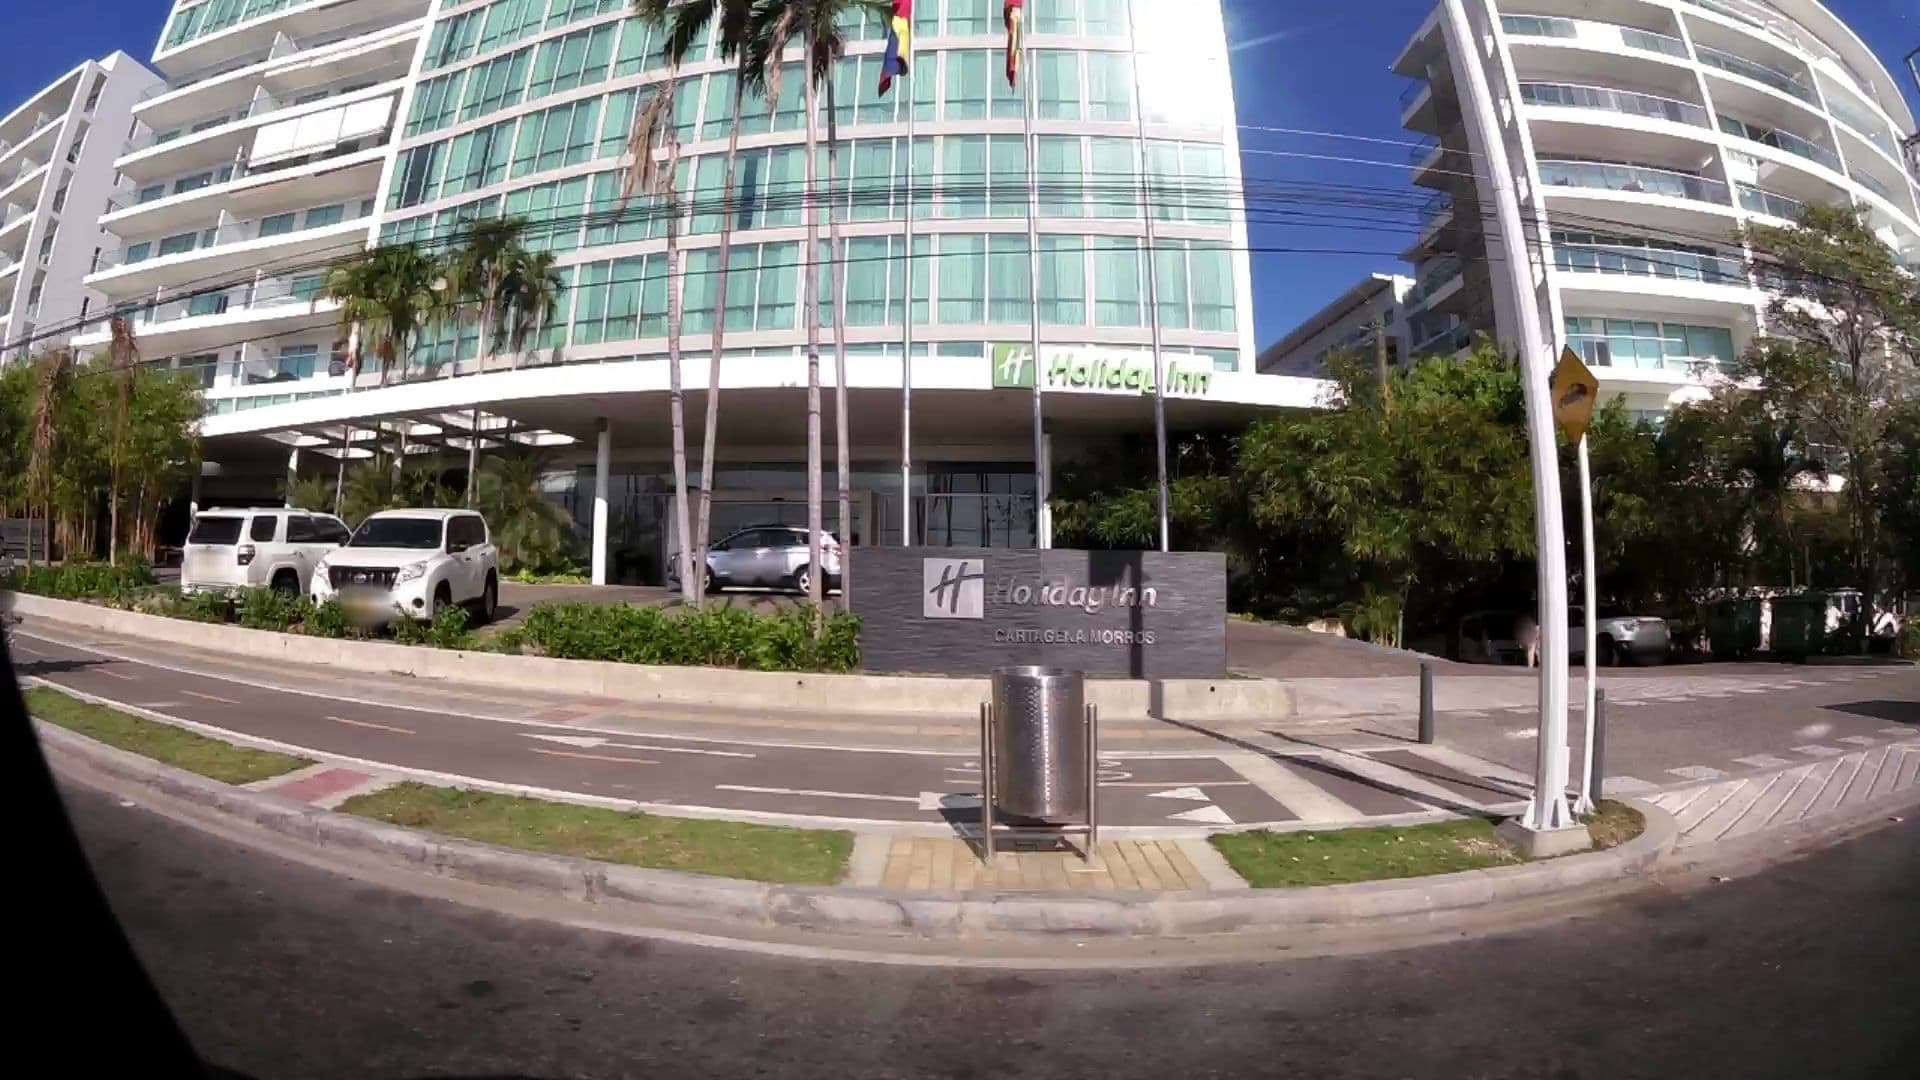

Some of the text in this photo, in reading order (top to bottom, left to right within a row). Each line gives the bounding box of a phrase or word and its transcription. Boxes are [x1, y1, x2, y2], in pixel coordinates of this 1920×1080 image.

[1166, 361, 1213, 395] Inn
[1109, 578, 1157, 607] Inn
[995, 628, 1155, 645] CARTAGENA MORROS
